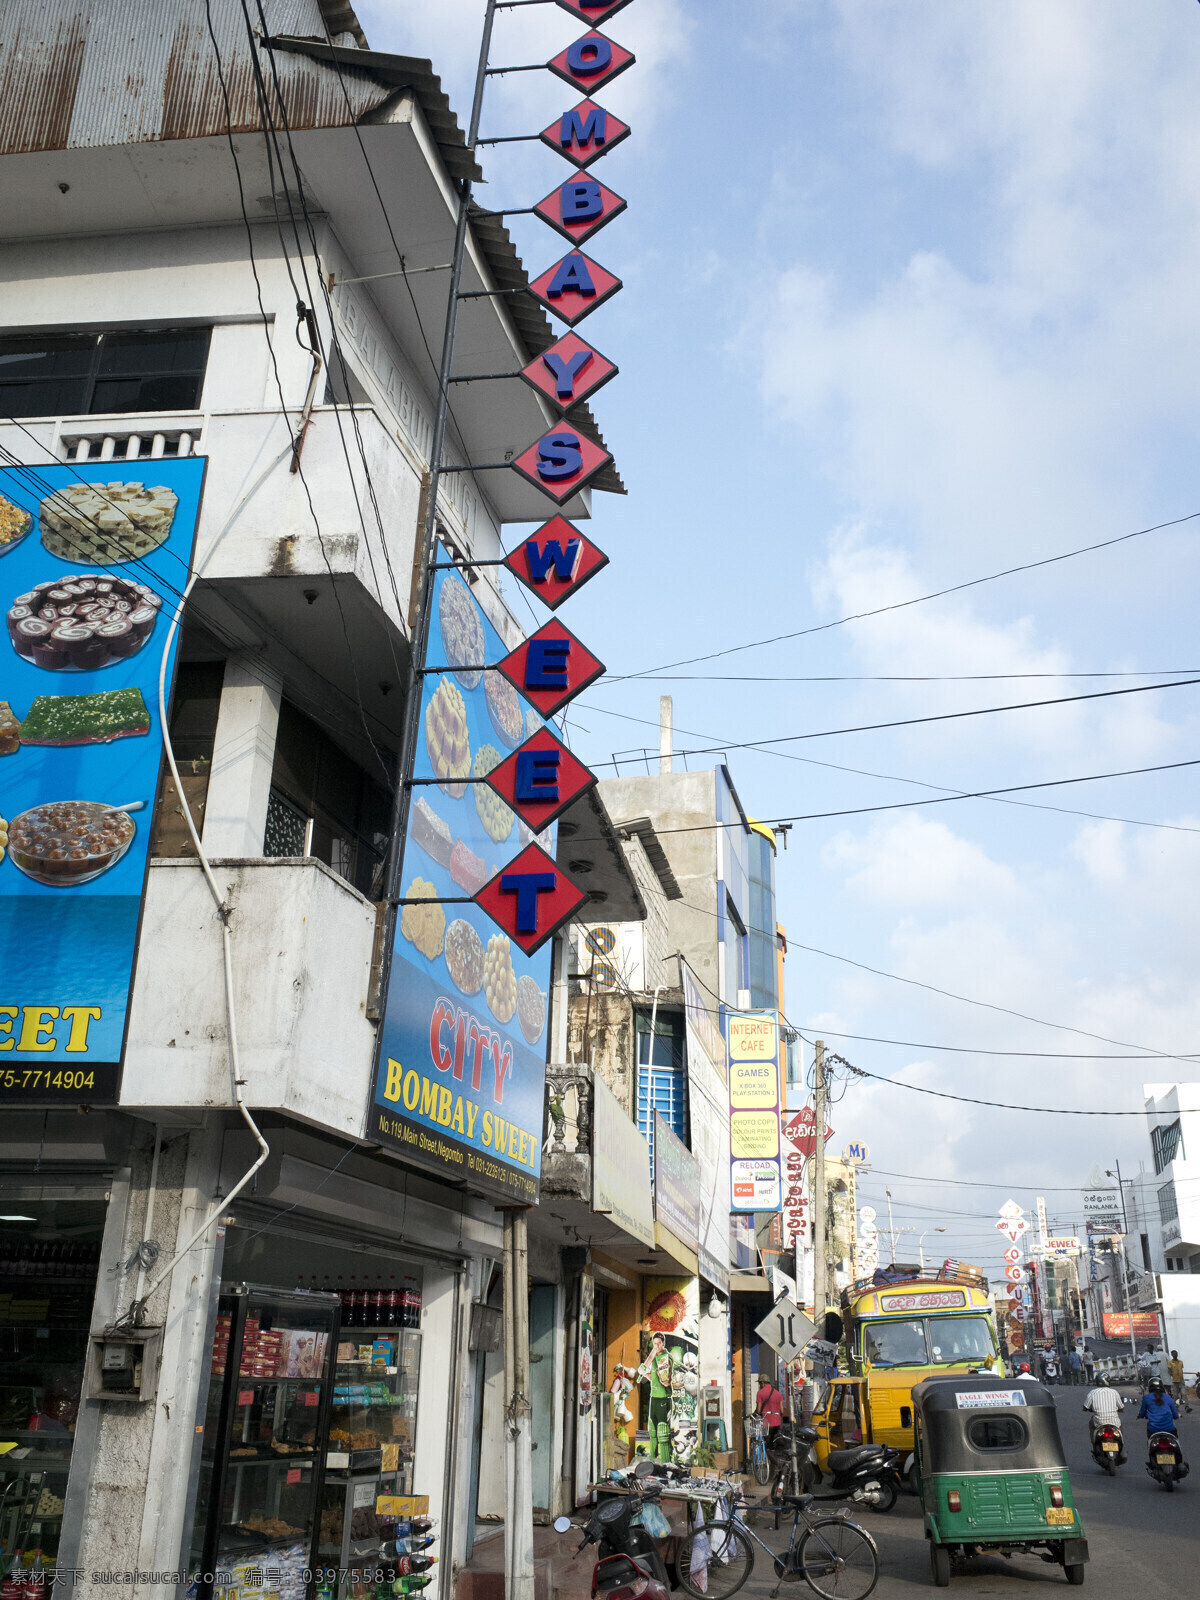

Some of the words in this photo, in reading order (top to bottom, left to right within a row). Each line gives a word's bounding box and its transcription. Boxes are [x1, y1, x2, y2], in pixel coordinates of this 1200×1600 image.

[730, 1023, 774, 1035] INTERNET
[430, 996, 514, 1105] CITY
[740, 1040, 765, 1051] CAFE
[737, 1068, 770, 1078] GAMES
[383, 1057, 479, 1138] BOMBAY
[481, 1109, 538, 1168] SWEET
[757, 1118, 775, 1126] COPY
[467, 1153, 475, 1169] Tel
[740, 1161, 771, 1169] RELOAD
[848, 1171, 856, 1221] MANOMA
[1045, 1239, 1077, 1249] JEWEL
